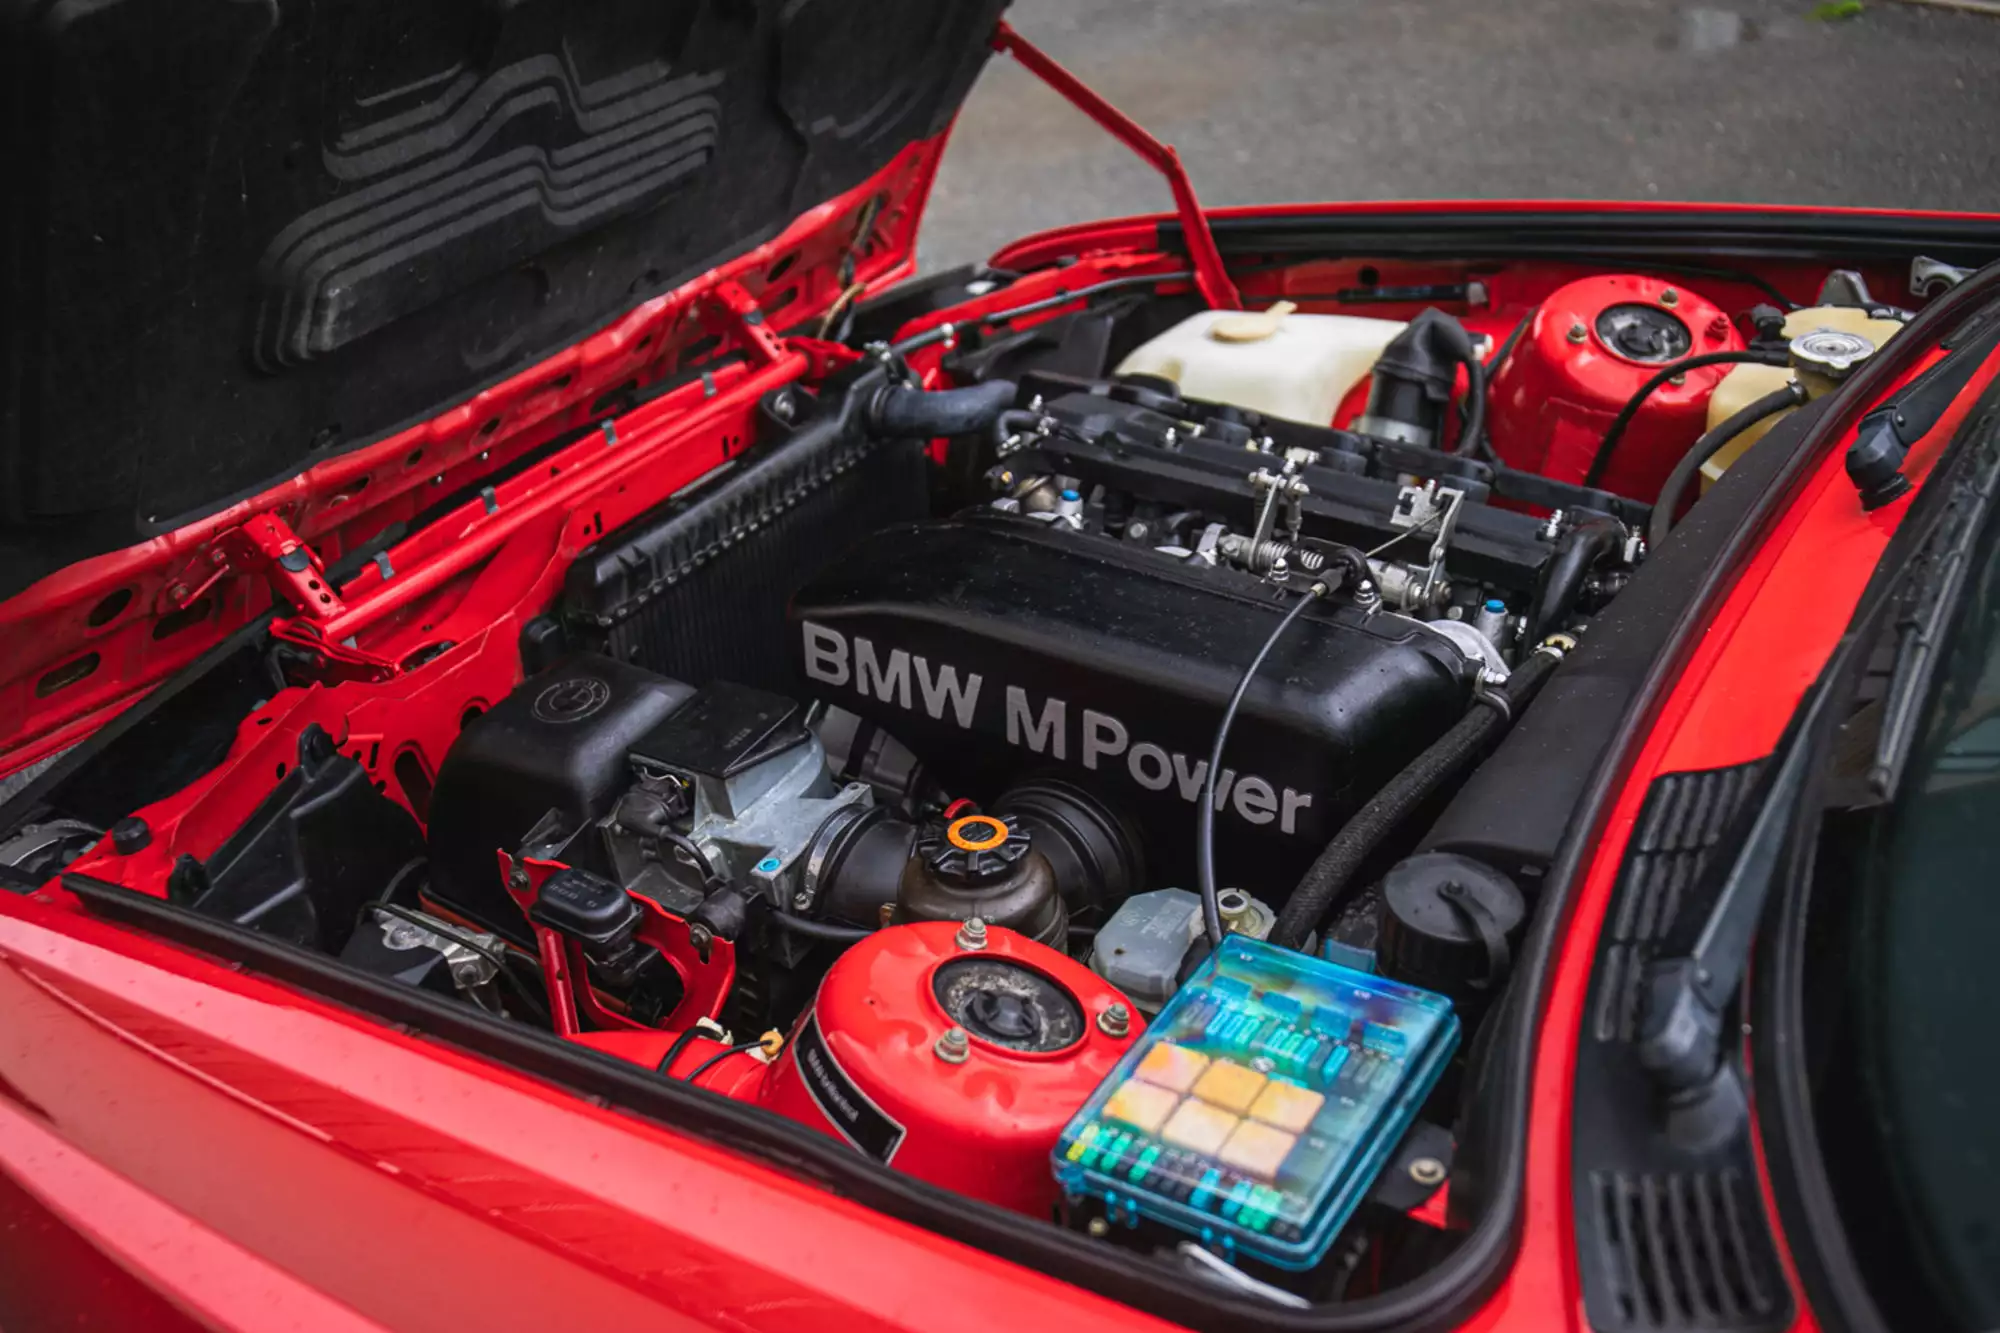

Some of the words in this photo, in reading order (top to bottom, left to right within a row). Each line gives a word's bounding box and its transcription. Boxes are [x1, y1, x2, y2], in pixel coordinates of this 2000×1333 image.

[803, 620, 982, 728] BMW
[1006, 685, 1066, 760] M
[1082, 709, 1312, 834] Power
